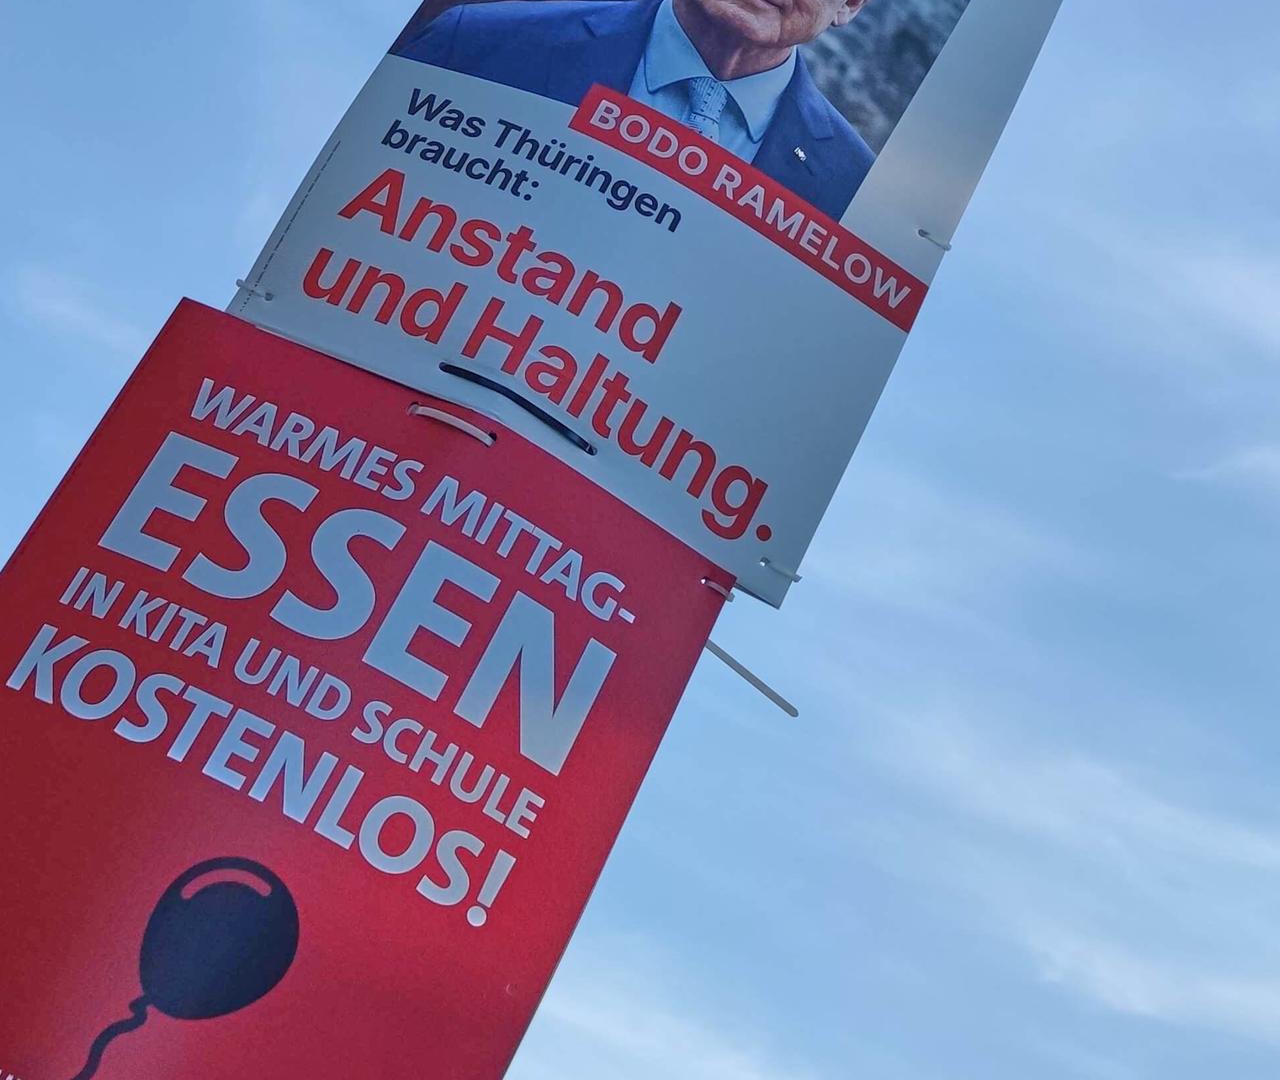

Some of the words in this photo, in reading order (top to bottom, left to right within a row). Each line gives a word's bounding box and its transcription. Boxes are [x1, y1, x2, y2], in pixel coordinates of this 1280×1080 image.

[337, 167, 683, 365] Anstand
[381, 120, 540, 202] braucht:
[407, 87, 483, 140] Was
[494, 119, 682, 233] Thüringen
[589, 97, 708, 178] BODO
[711, 168, 912, 310] RAMELOW
[191, 377, 424, 500] WARMES
[419, 478, 635, 624] MITTAG-
[302, 247, 468, 350] und
[460, 296, 774, 543] Haltung.
[58, 567, 125, 619] IN
[118, 597, 229, 669] KITA
[232, 638, 352, 721] UND
[350, 701, 546, 839] SCHULE
[96, 431, 618, 777] ESSEN
[5, 624, 517, 928] KOSTENLOS!
